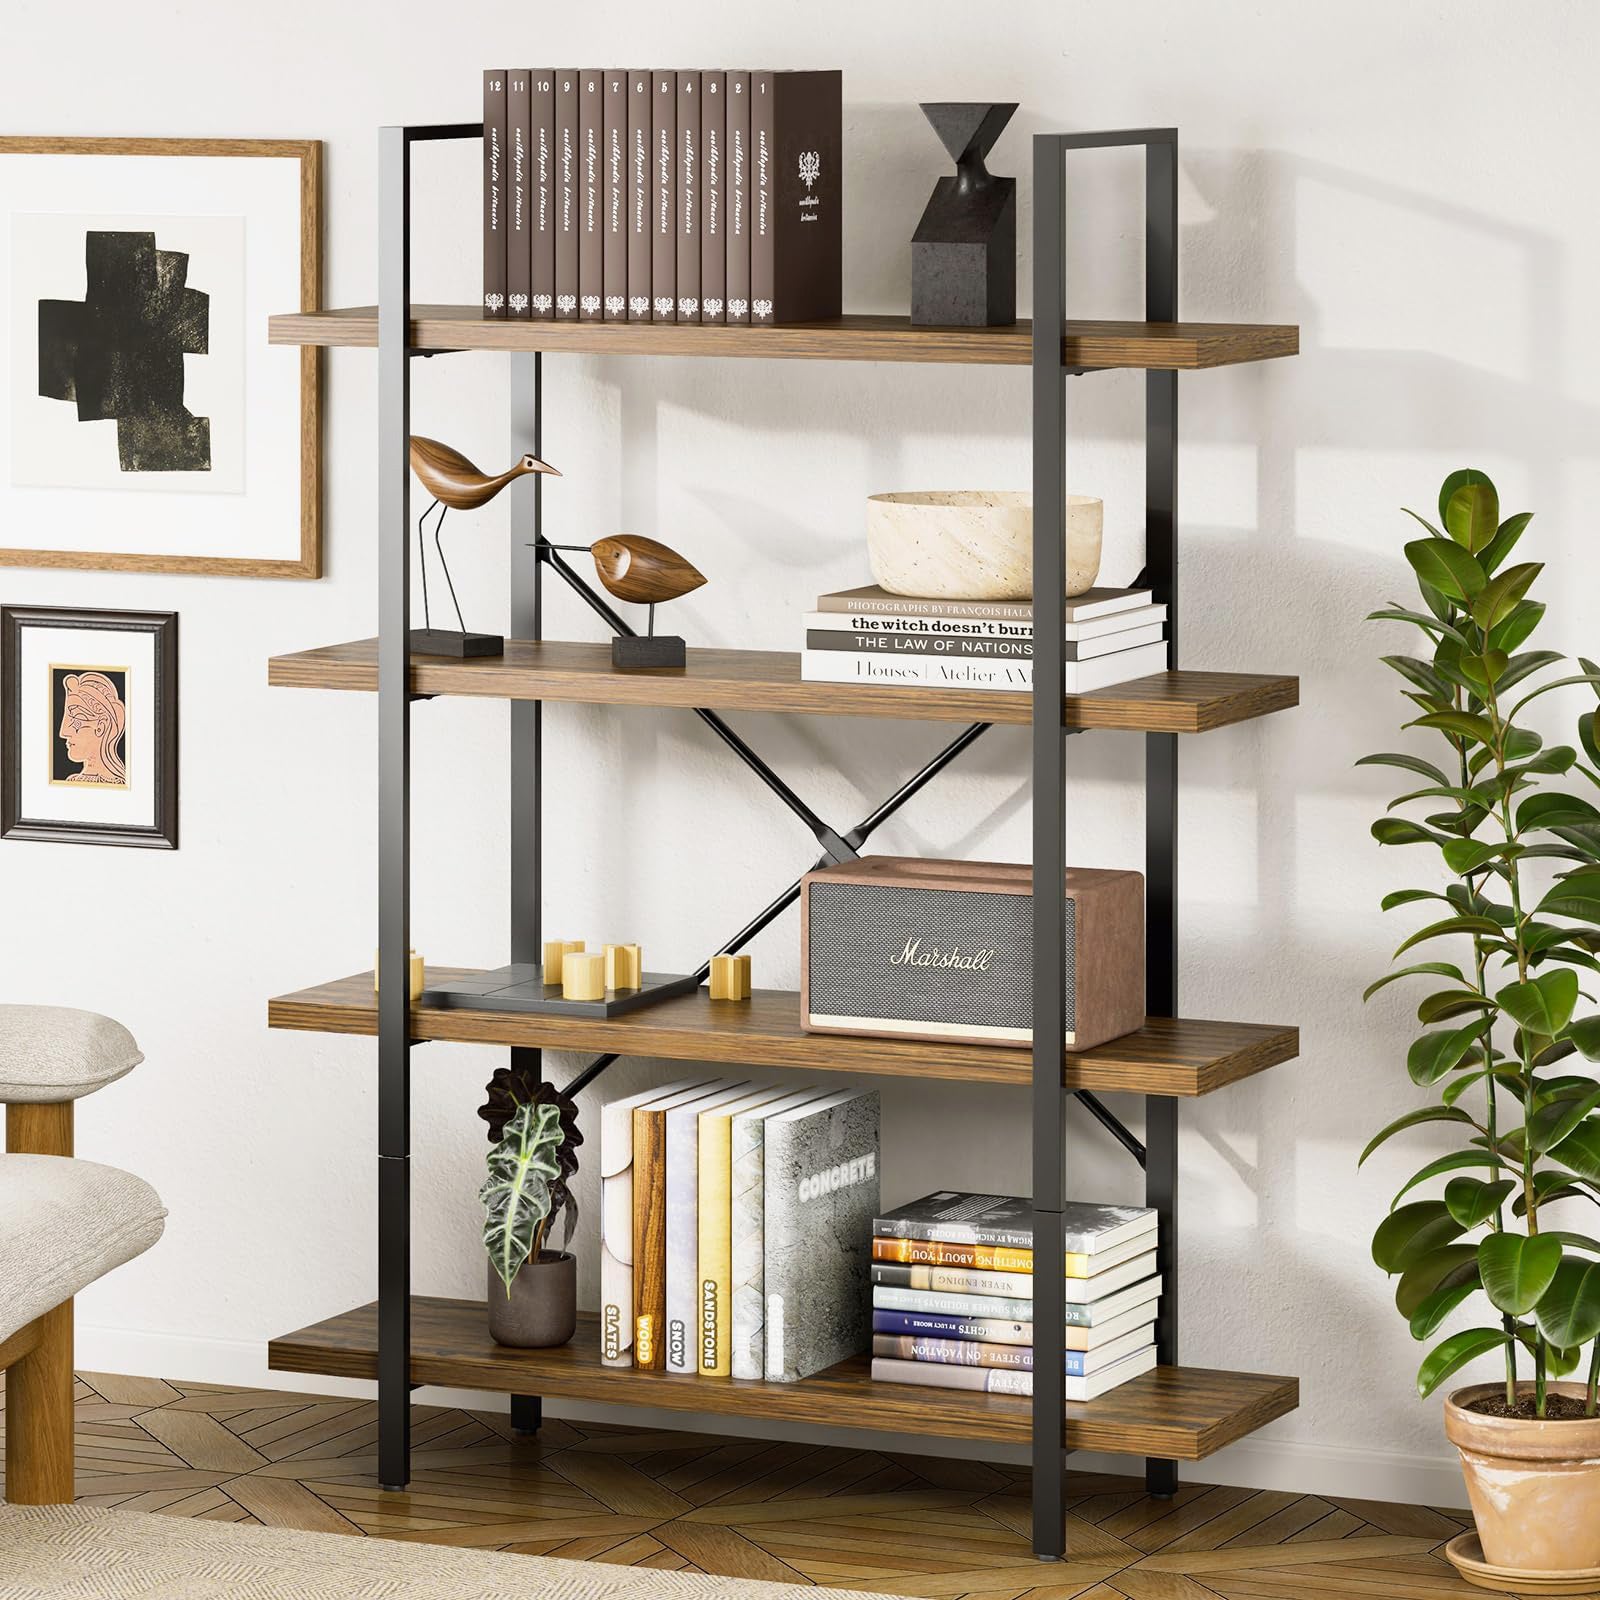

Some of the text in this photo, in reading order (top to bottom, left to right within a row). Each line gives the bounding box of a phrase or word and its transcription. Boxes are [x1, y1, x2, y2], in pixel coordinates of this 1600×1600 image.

[489, 80, 502, 92] 12
[513, 80, 524, 92] 11
[537, 80, 550, 92] 10
[563, 81, 571, 93] 9
[587, 81, 595, 93] 8
[612, 81, 619, 93] 7
[636, 82, 644, 93] 6
[661, 81, 668, 93] 5
[685, 82, 693, 94] 4
[735, 82, 742, 94] 2
[760, 82, 765, 94] 1
[848, 601, 928, 613] PHOTOGRAPHS
[932, 603, 944, 613] BY
[947, 605, 1000, 617] FRANÇOIS
[852, 618, 879, 630] the
[881, 618, 930, 632] witch
[856, 636, 1033, 655] THE LAW OF NATIONS
[857, 660, 919, 678] Houses
[937, 665, 996, 682] Atelier
[891, 937, 994, 971] Marshall
[799, 1152, 876, 1202] CONCRETE
[997, 1234, 1007, 1243] BY
[1007, 1235, 1033, 1245] NIGMA
[912, 1249, 1033, 1269] OMETHING ABOUT YOU
[938, 1276, 1013, 1290] NEVER ENDING
[924, 1300, 969, 1310] HOLIDAYS
[703, 1280, 717, 1368] SANDSTONE
[913, 1320, 933, 1328] MOORE
[934, 1322, 948, 1330] LUCY
[605, 1304, 619, 1360] SLATES
[638, 1315, 651, 1363] WOOD
[671, 1320, 684, 1366] SNOW
[911, 1345, 963, 1359] VACATION
[966, 1350, 981, 1361] ON
[990, 1353, 1020, 1364] STEVE
